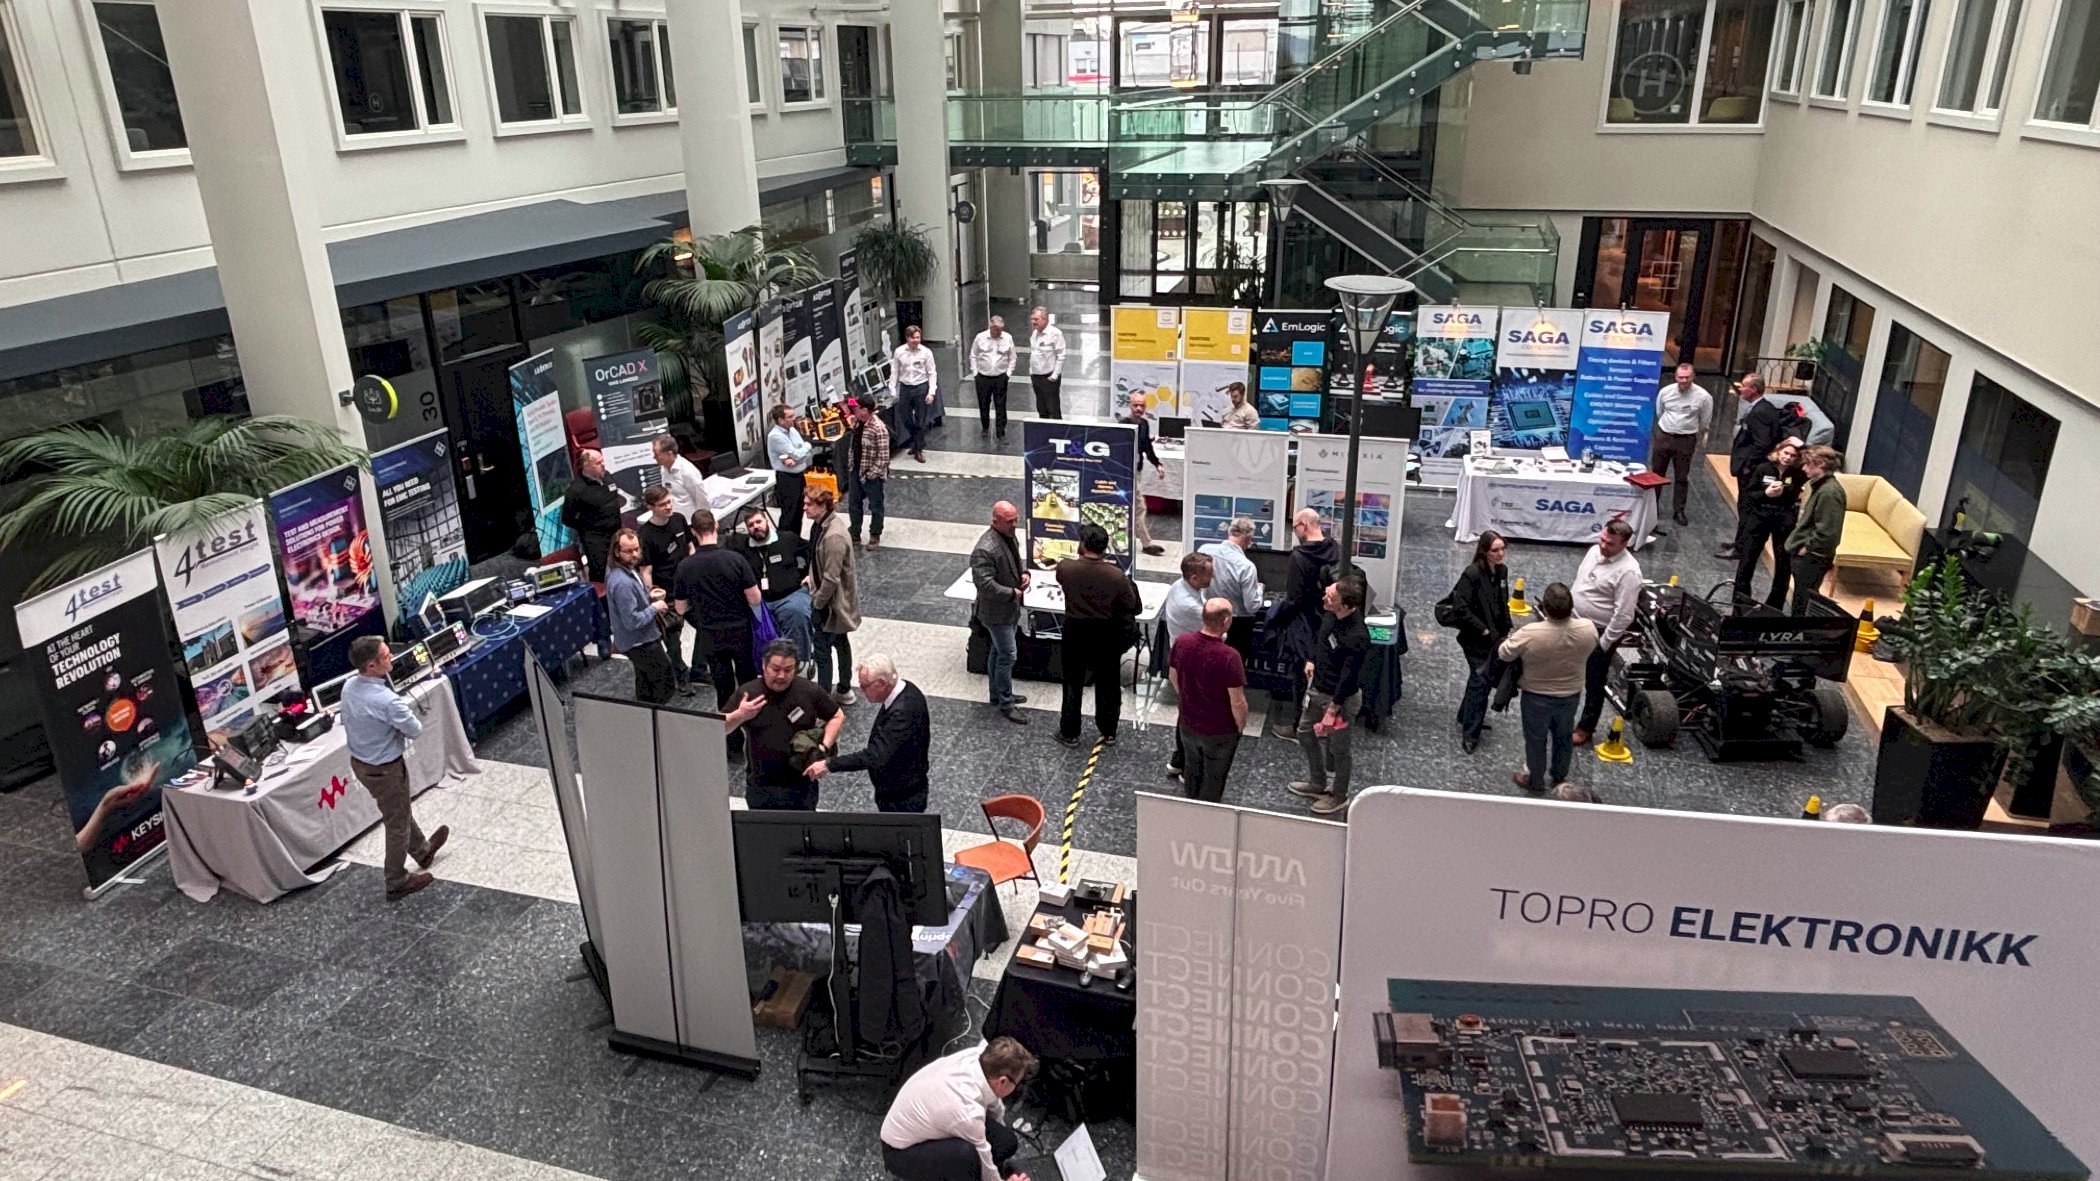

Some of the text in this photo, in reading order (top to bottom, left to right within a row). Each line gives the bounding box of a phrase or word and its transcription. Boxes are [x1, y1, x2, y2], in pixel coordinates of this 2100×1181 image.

[1281, 322, 1326, 334] EmLogic
[1433, 313, 1482, 325] SAGA
[1589, 320, 1653, 336] SAGA
[1508, 330, 1570, 344] SAGA
[595, 360, 648, 381] OrCAD X
[420, 391, 438, 421] 30
[1048, 438, 1111, 457] T&G
[382, 487, 394, 498] ALL
[393, 483, 405, 495] YOU
[383, 495, 396, 508] FOR
[1535, 499, 1596, 514] SAGA
[283, 526, 299, 539] TEST
[297, 520, 310, 533] AND
[309, 505, 349, 530] MEASUREMENT
[285, 515, 345, 546] SOLUTIONS FOR POWER
[174, 519, 258, 588] 4test
[286, 534, 322, 554] ELECTRONICS
[65, 573, 123, 624] 4test
[46, 624, 94, 656] AT THE HEART
[1759, 632, 1805, 642] LYRA
[49, 642, 81, 664] OF YOUR
[51, 632, 121, 677] TECHNOLOGY
[55, 647, 122, 690] REVOLUTION
[131, 811, 163, 841] KEYSI
[1490, 887, 2038, 968] TOPRO ELEKTRONIKK
